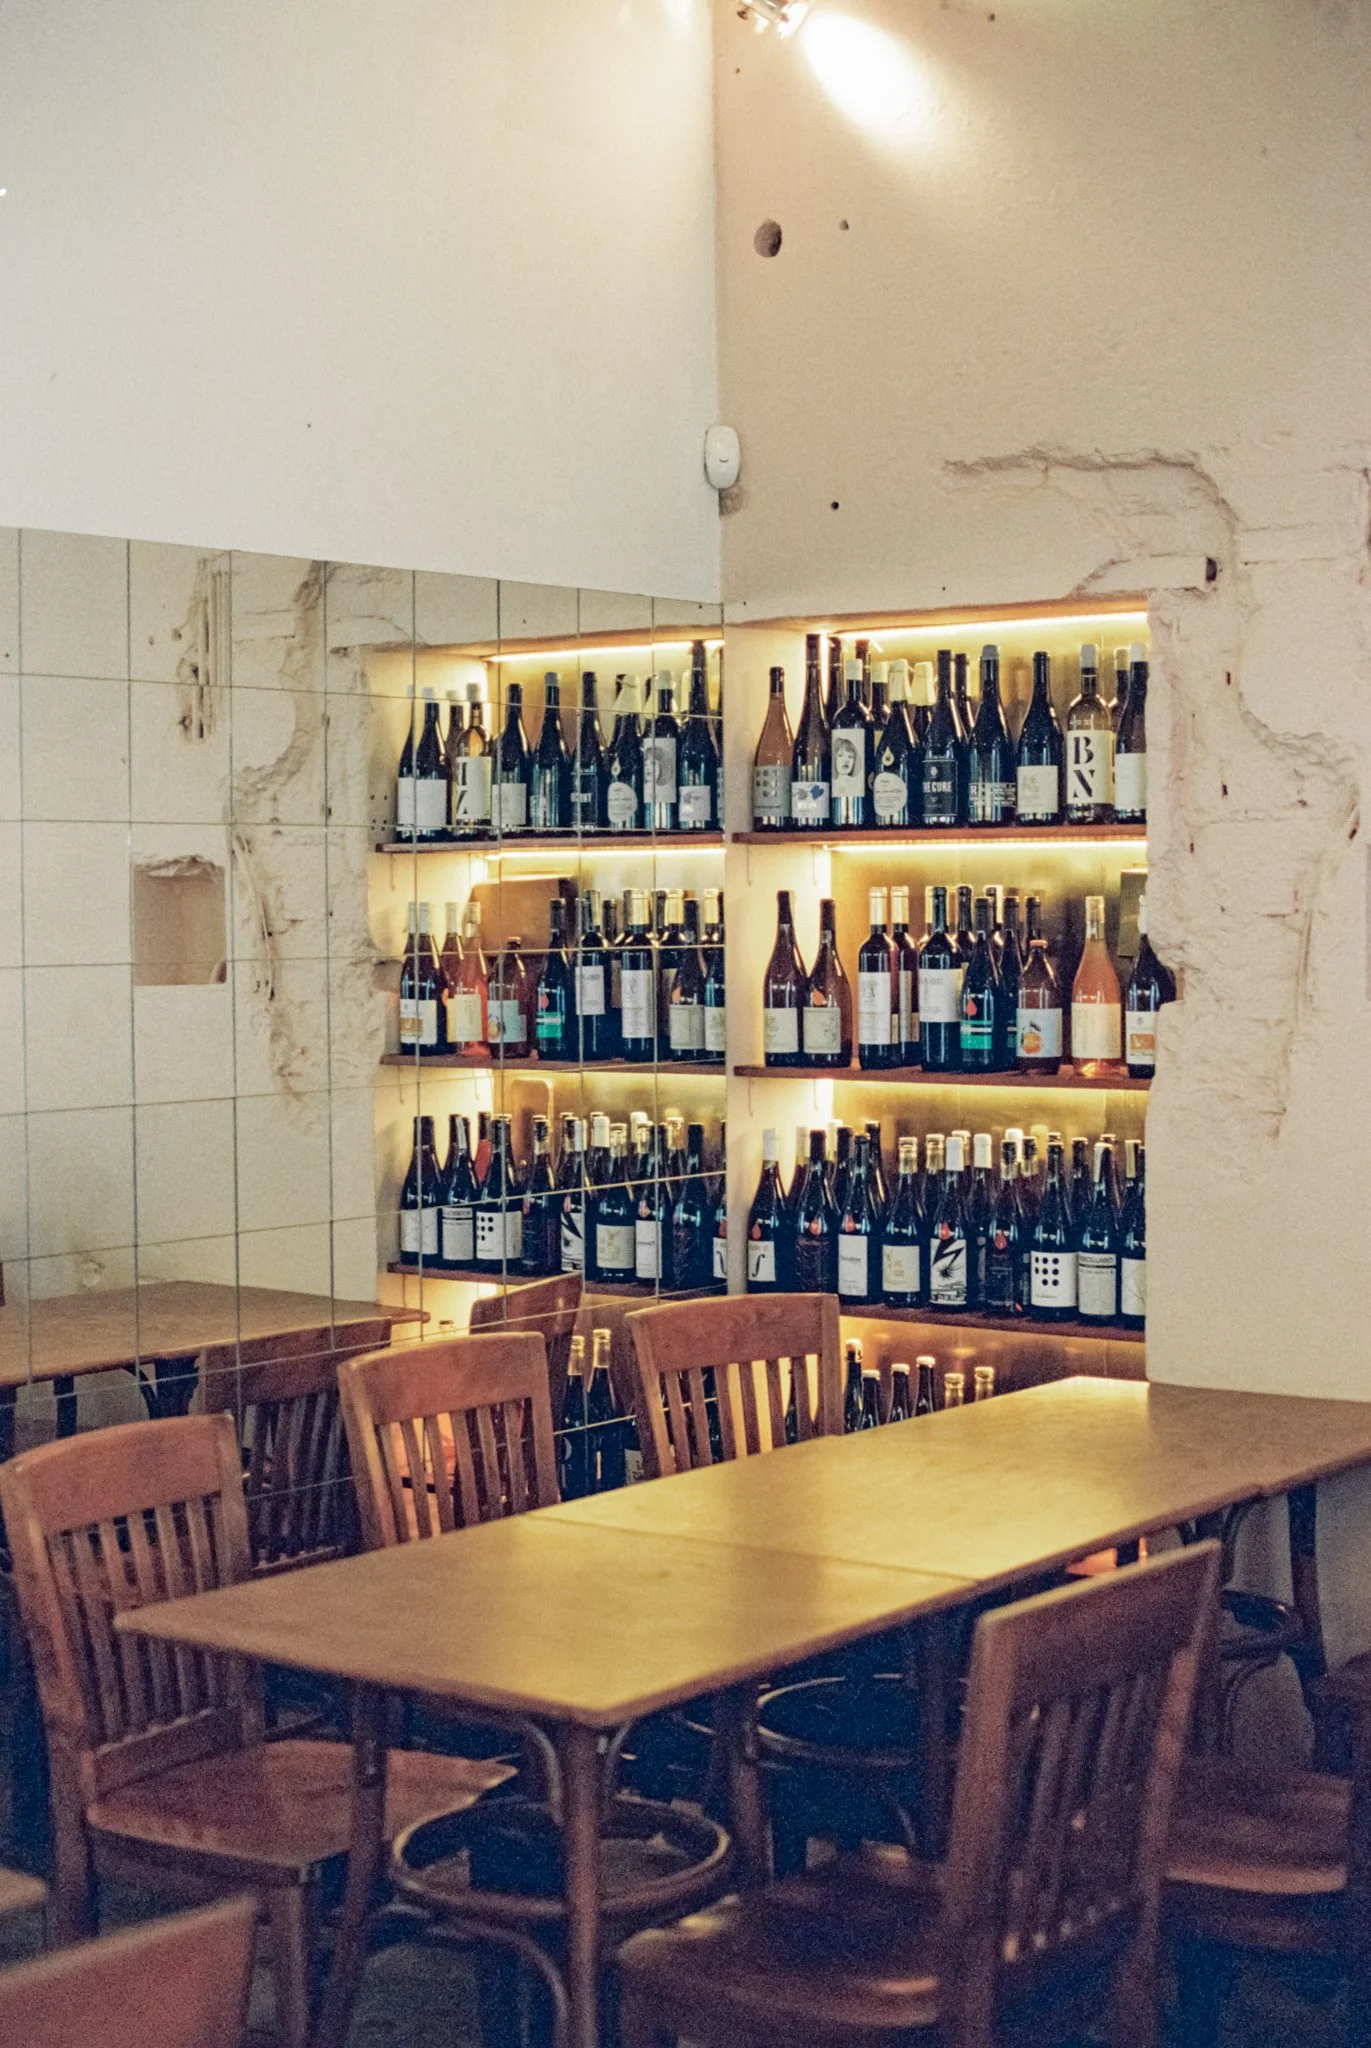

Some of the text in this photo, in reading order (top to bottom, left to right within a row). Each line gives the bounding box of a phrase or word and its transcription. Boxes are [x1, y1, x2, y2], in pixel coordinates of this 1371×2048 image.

[1073, 736, 1095, 765] B
[931, 781, 952, 793] CURE
[1073, 769, 1096, 798] N
